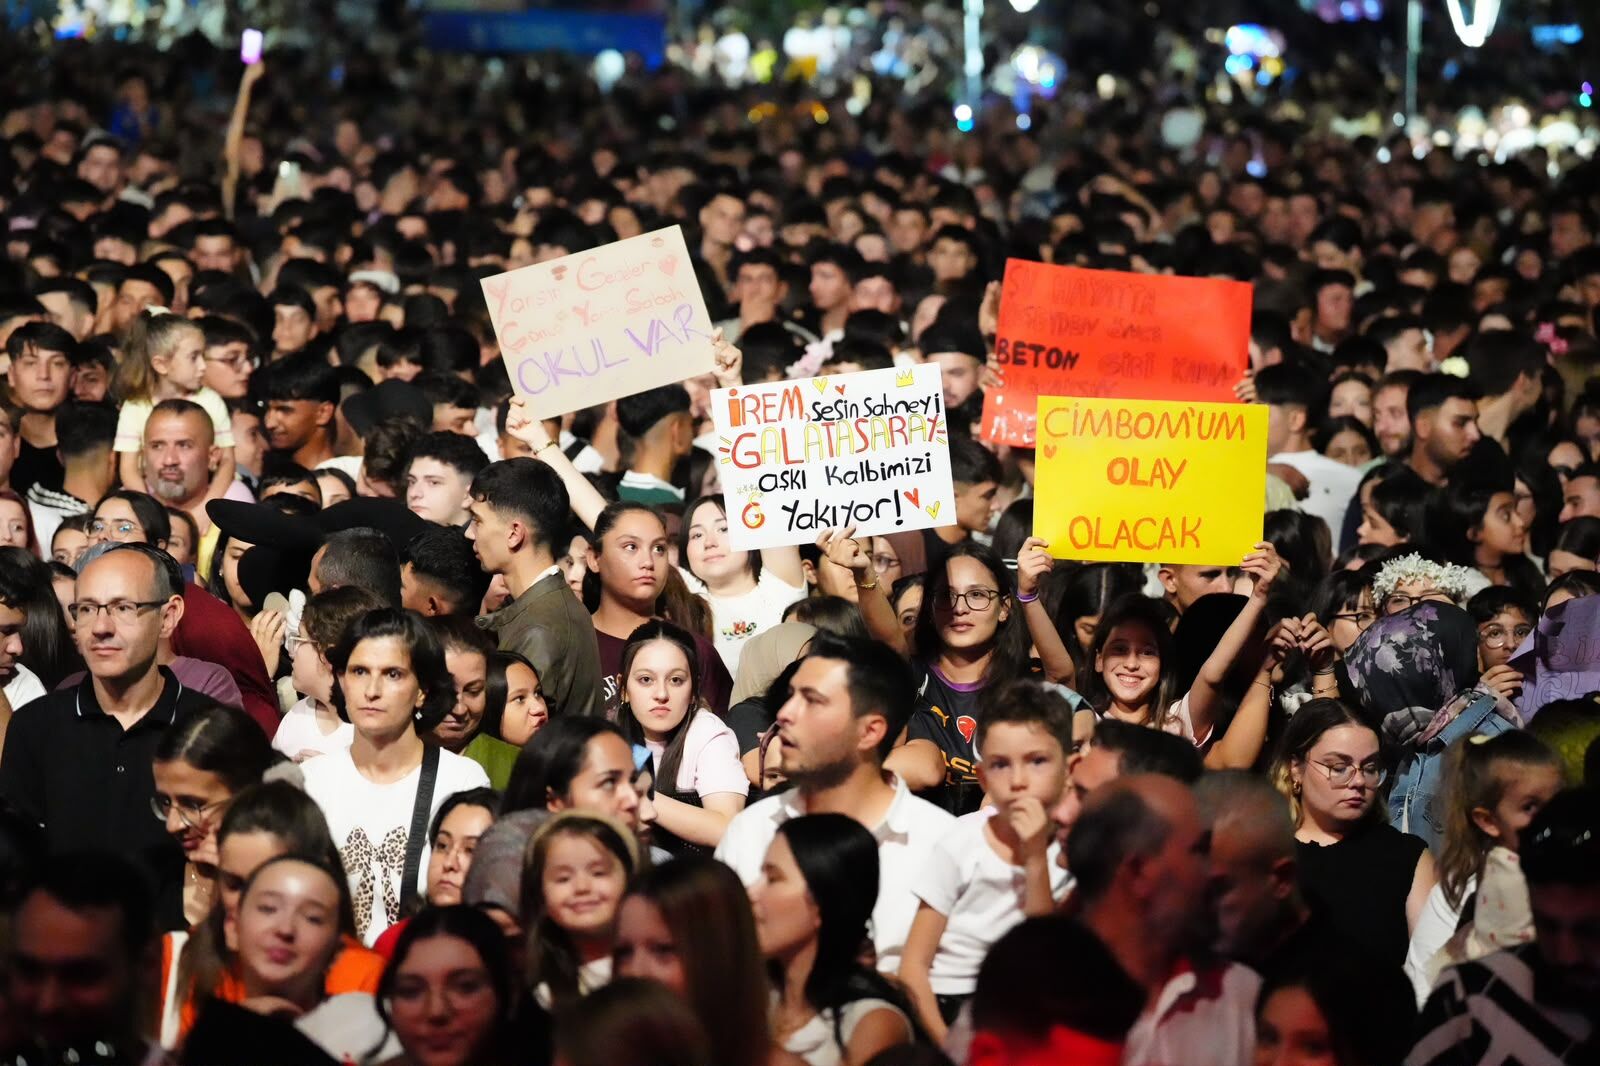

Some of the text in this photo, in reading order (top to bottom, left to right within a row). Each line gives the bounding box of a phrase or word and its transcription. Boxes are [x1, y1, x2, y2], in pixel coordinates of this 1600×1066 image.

[517, 336, 630, 396] OKUL
[624, 303, 712, 357] VAR
[996, 338, 1081, 372] BETON
[731, 413, 940, 469] GALATASARAY
[1106, 456, 1188, 490] OLAY
[1068, 515, 1202, 551] OLACAK
